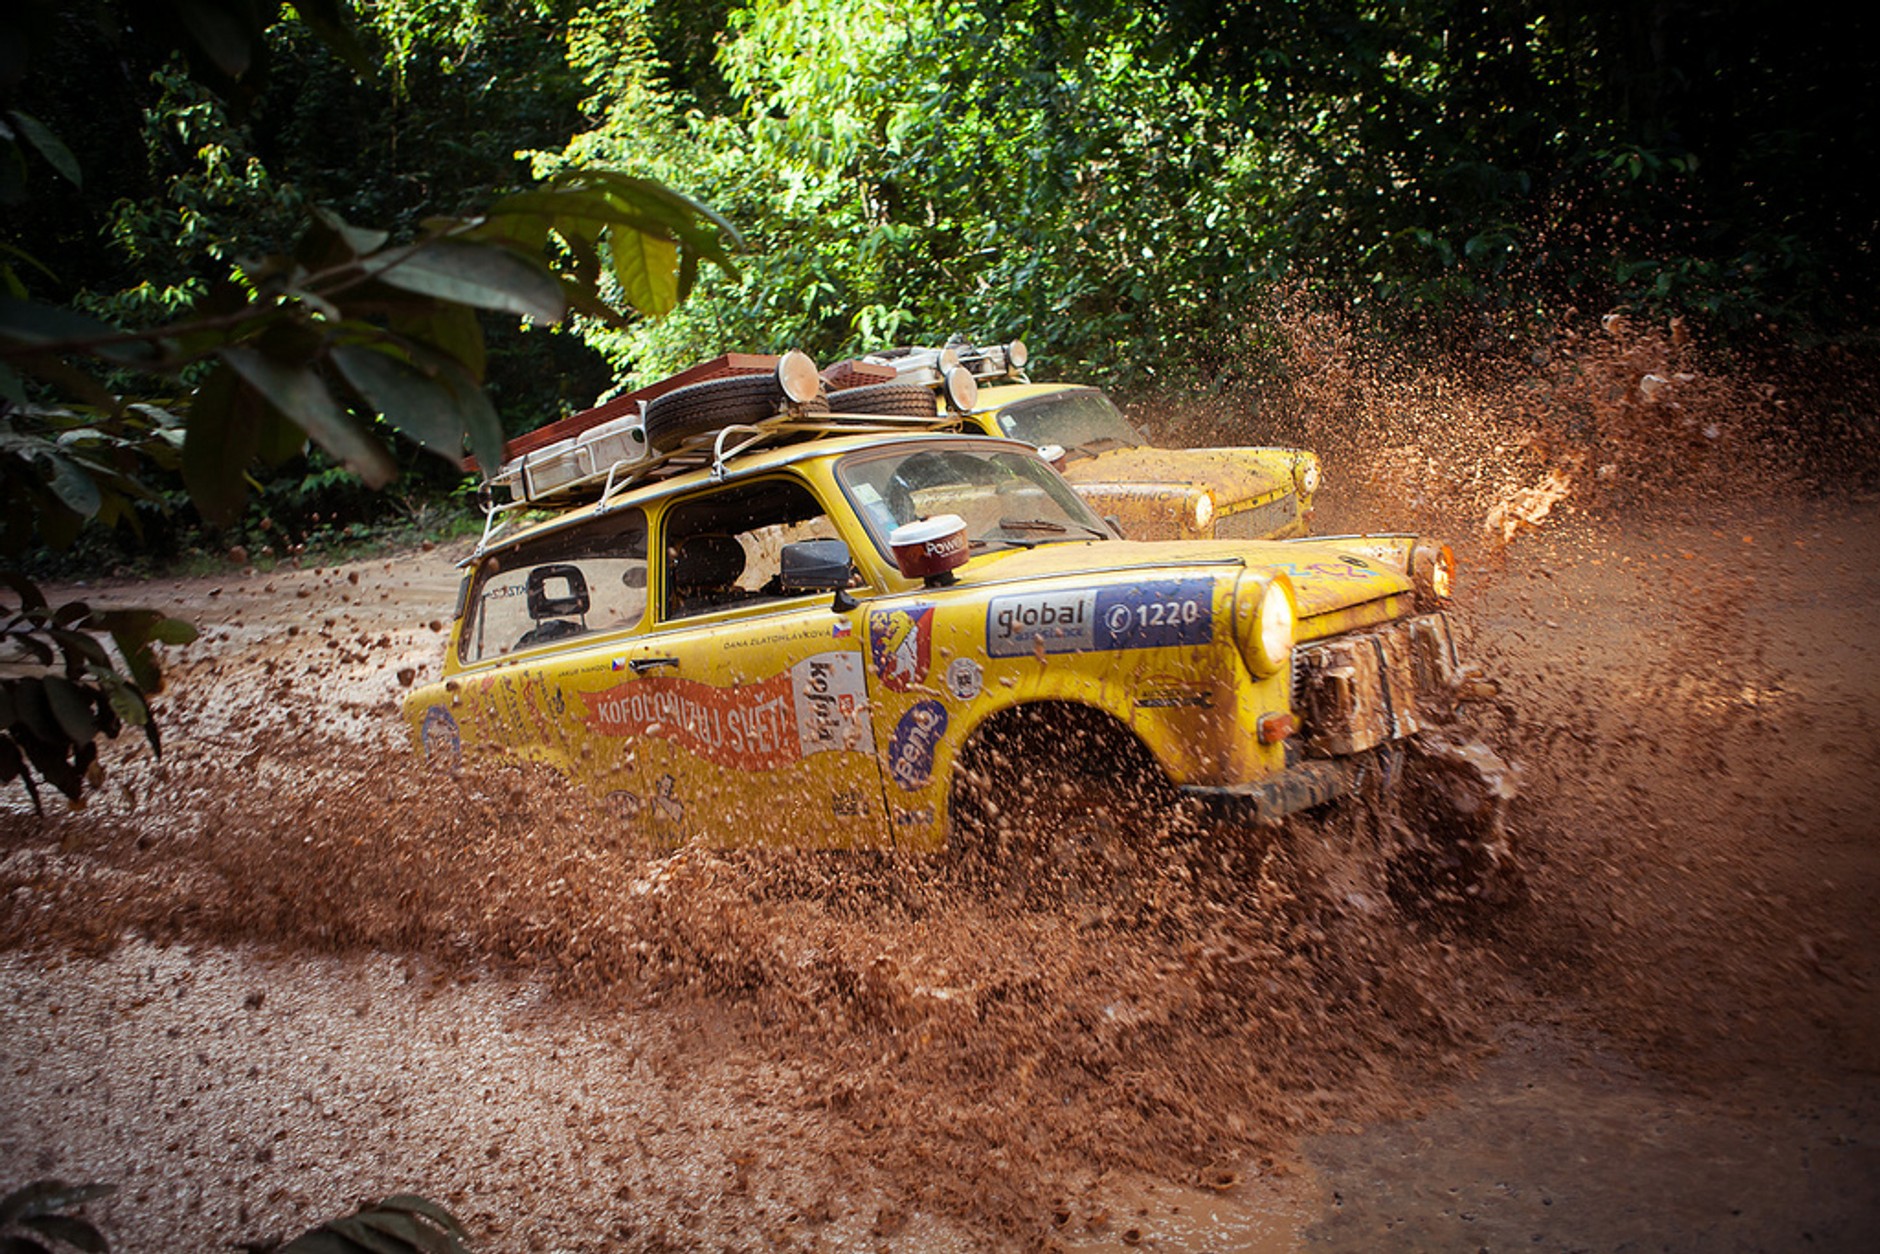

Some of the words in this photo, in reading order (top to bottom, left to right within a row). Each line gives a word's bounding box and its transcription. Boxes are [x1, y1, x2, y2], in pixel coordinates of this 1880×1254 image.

[998, 600, 1084, 638] global
[1136, 600, 1198, 628] 1220
[723, 640, 748, 650] DANA
[597, 690, 723, 748] KOFOLONIZUJ
[726, 691, 790, 754] SVĚT!
[895, 710, 940, 783] BenQ
